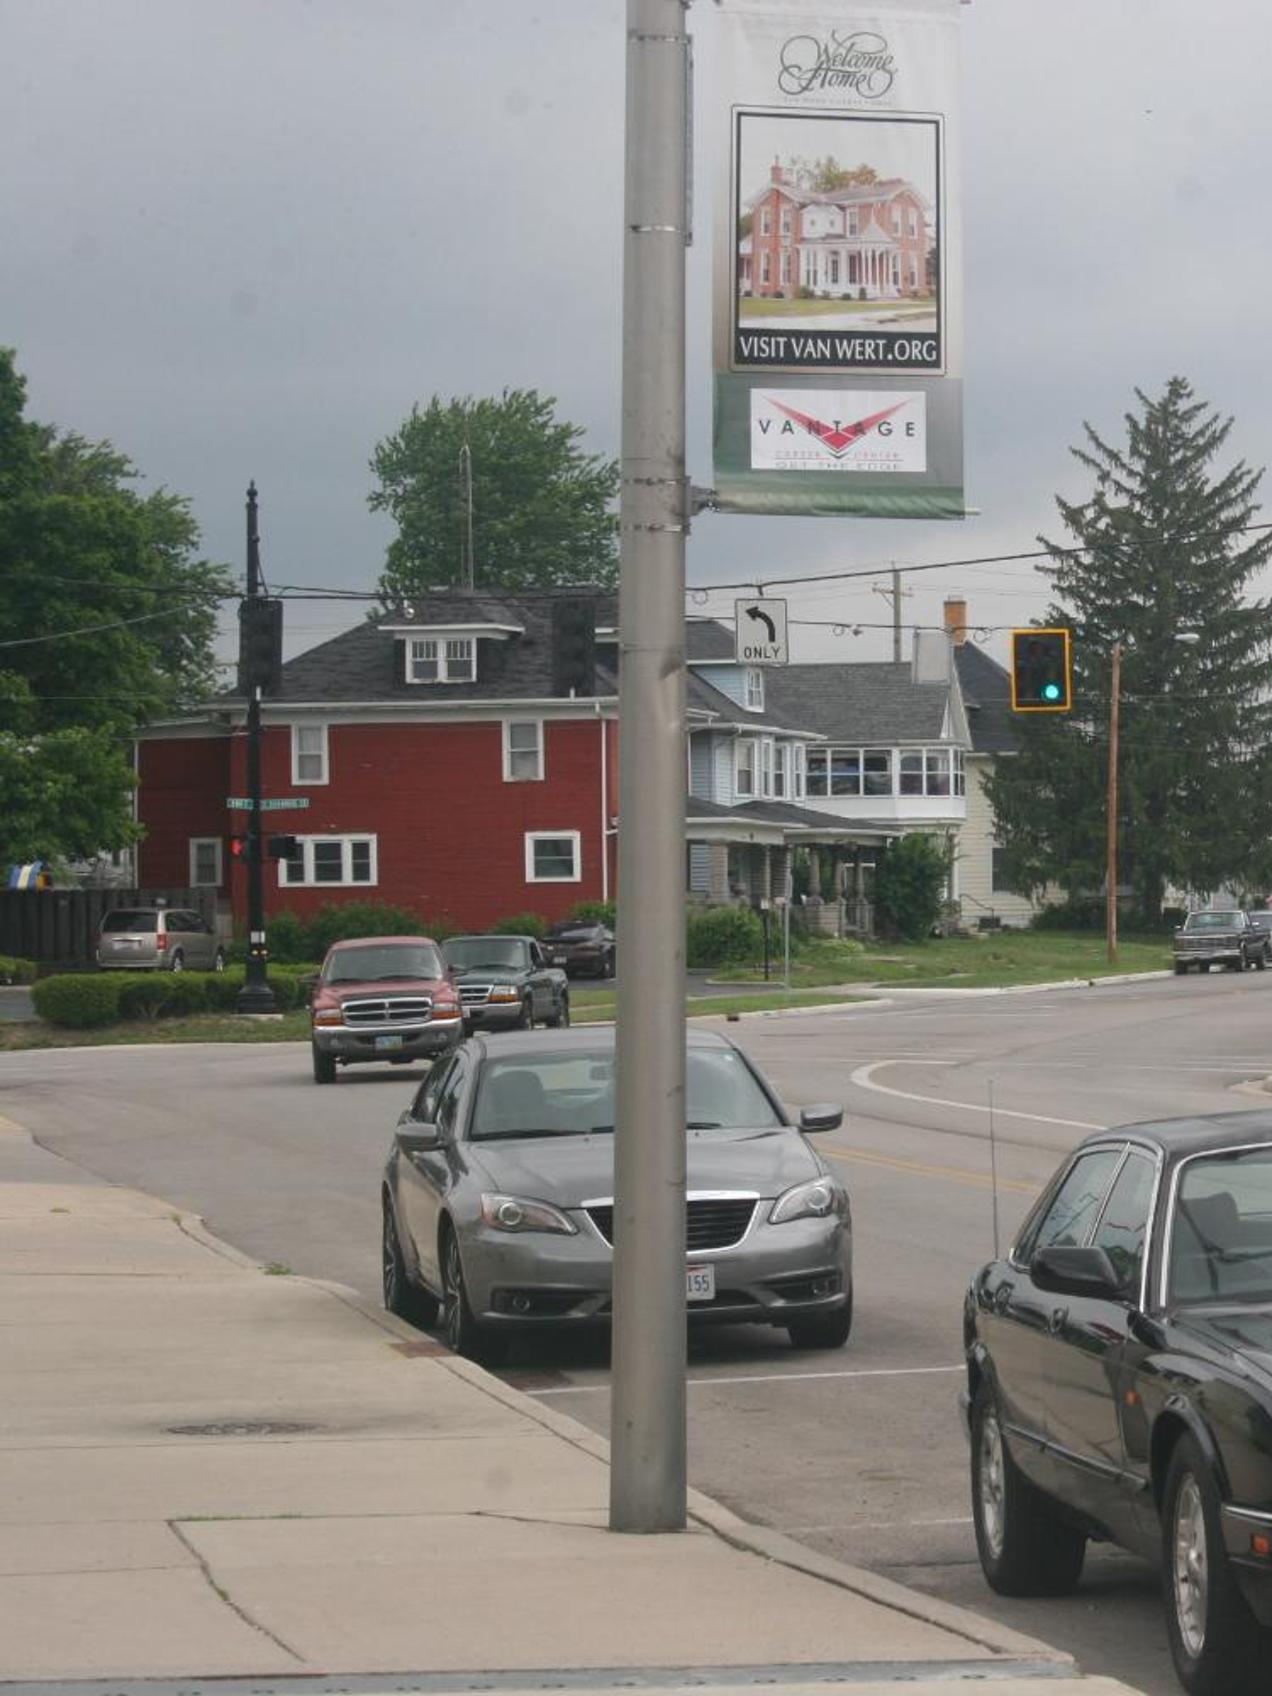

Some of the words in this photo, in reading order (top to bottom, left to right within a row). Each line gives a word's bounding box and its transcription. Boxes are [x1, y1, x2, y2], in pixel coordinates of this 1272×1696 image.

[780, 31, 895, 77] Welcome
[778, 64, 868, 94] Home
[740, 336, 787, 358] VISIT
[791, 338, 830, 359] VAN
[835, 339, 937, 362] WERT.ORG
[759, 420, 915, 438] VANTAGE
[744, 646, 781, 659] ONLY
